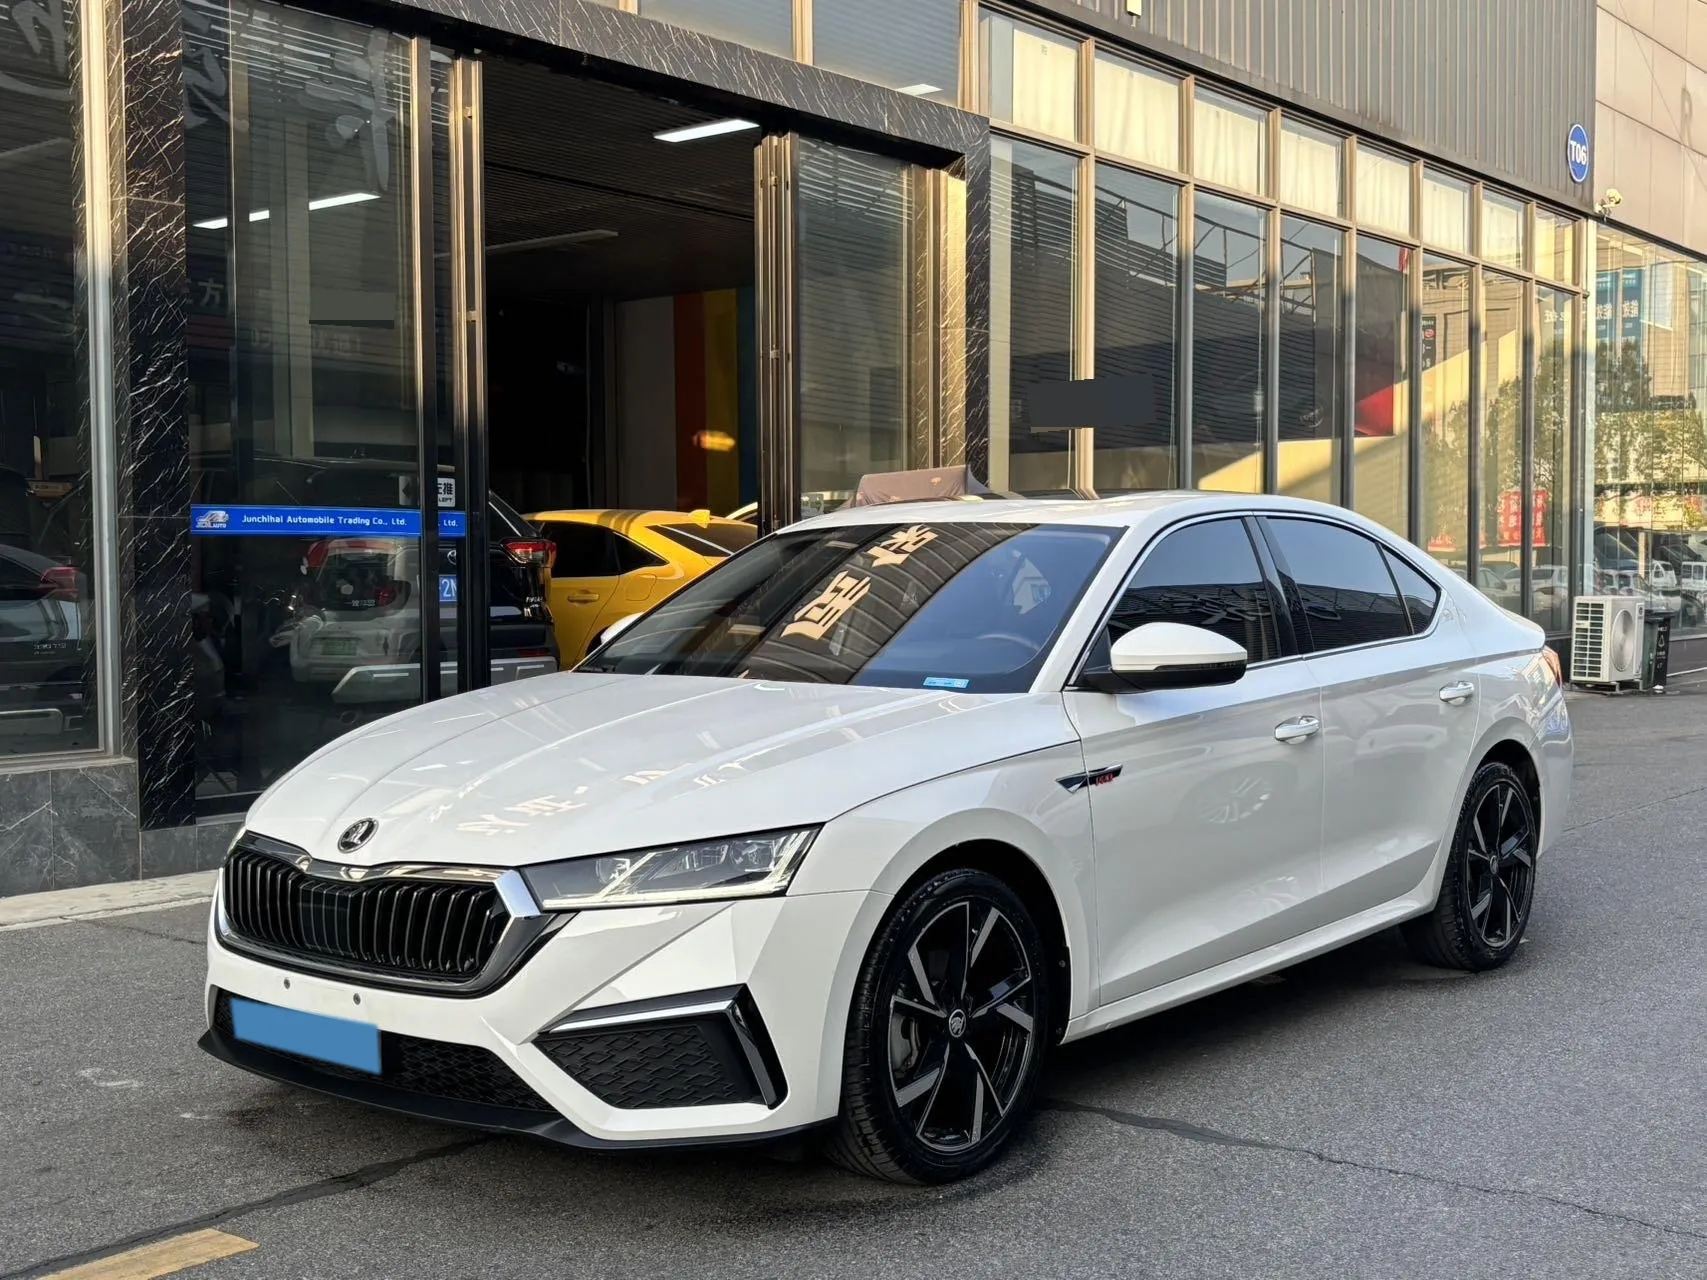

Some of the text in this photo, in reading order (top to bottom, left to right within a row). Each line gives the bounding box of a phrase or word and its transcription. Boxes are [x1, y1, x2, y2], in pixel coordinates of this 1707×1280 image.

[1569, 140, 1588, 165] T06
[242, 515, 284, 523] Junchihai
[286, 515, 336, 524] Automobile
[338, 516, 371, 526] Trading
[391, 518, 408, 526] Ltd.
[443, 519, 459, 527] Ltd.
